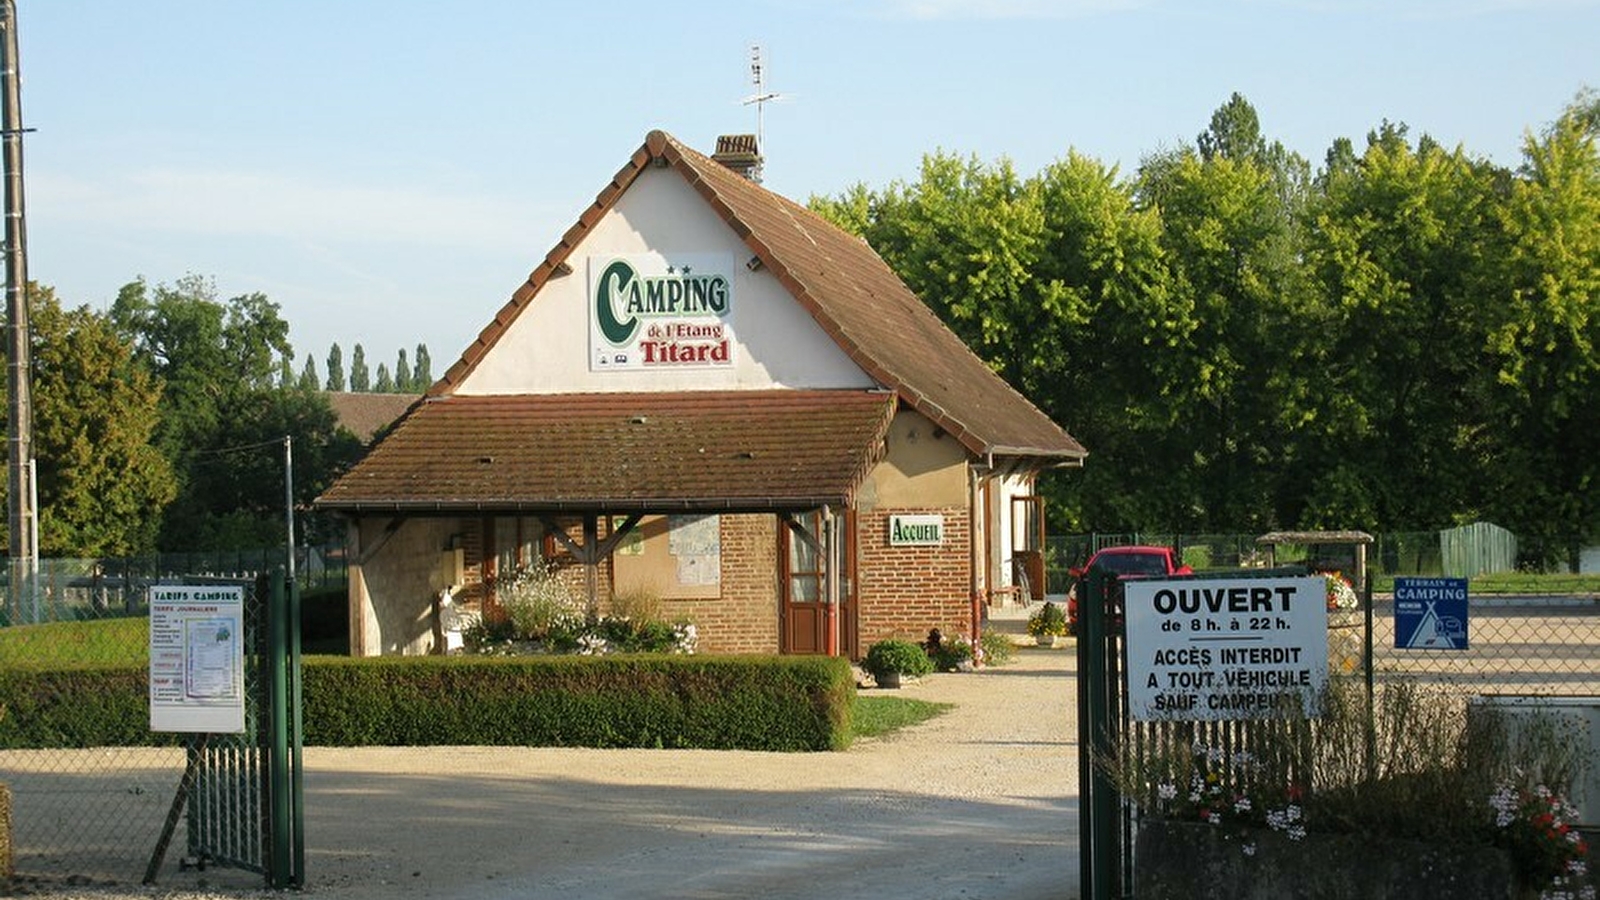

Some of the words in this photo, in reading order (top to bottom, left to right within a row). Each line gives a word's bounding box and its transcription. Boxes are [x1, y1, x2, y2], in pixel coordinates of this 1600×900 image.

[597, 260, 726, 343] CAMPING
[648, 326, 661, 338] de
[640, 340, 729, 363] Titard
[892, 517, 941, 541] ACCUEIL
[1404, 579, 1446, 587] TERRAIN
[154, 592, 189, 600] TARIFS
[193, 592, 239, 600] CAMPING
[1153, 587, 1297, 614] OUVERT
[1396, 588, 1466, 600] CAMPING
[1161, 620, 1181, 632] de
[1190, 619, 1201, 631] 8
[1206, 619, 1221, 631] h.
[1230, 617, 1240, 631] à
[1249, 618, 1271, 630] 22
[1275, 617, 1291, 630] h.
[1154, 646, 1212, 666] ACCÈS
[1221, 647, 1302, 665] INTERDIT
[1147, 673, 1158, 688] A
[1167, 672, 1216, 689] TOUT
[1155, 694, 1199, 711] SAUF
